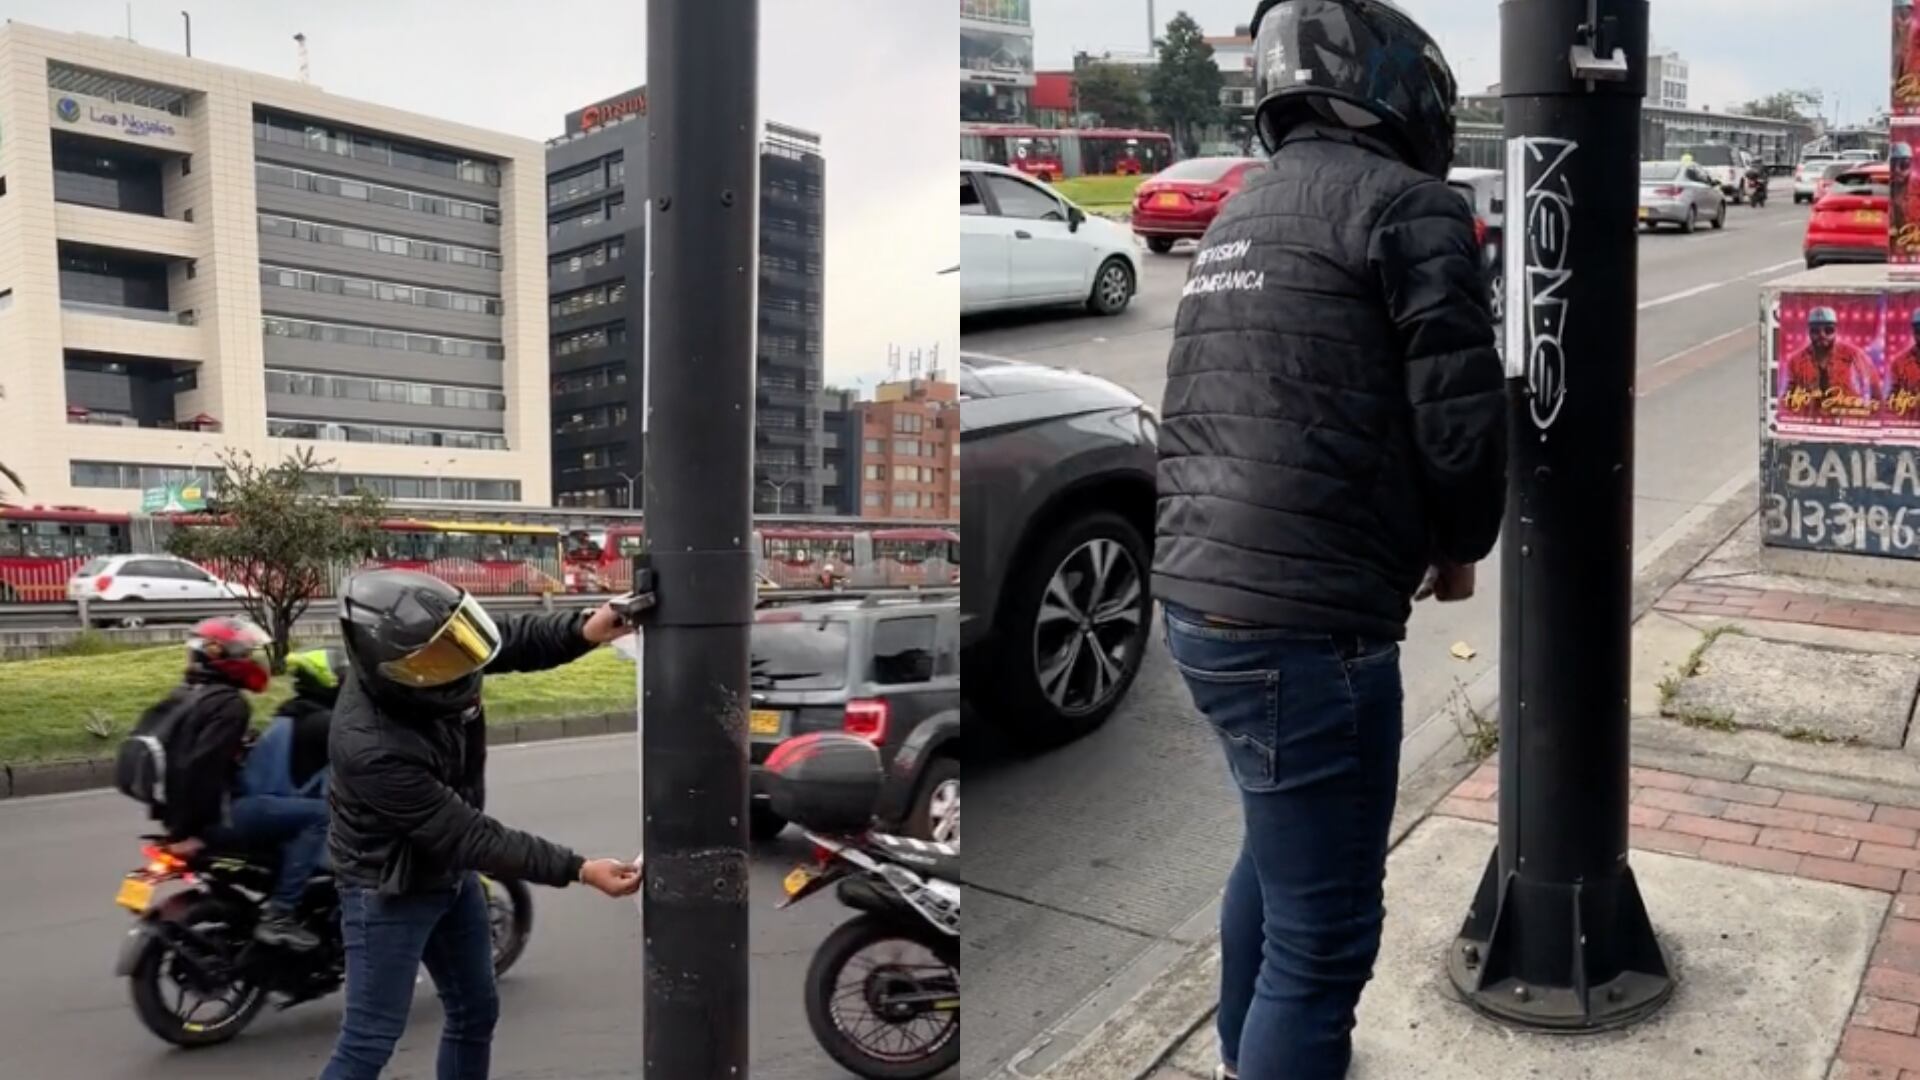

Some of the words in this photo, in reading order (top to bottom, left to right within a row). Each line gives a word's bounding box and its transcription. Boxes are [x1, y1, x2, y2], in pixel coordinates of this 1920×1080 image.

[89, 106, 118, 126] Los
[122, 112, 176, 137] Nogales
[1786, 448, 1920, 496] BAILA
